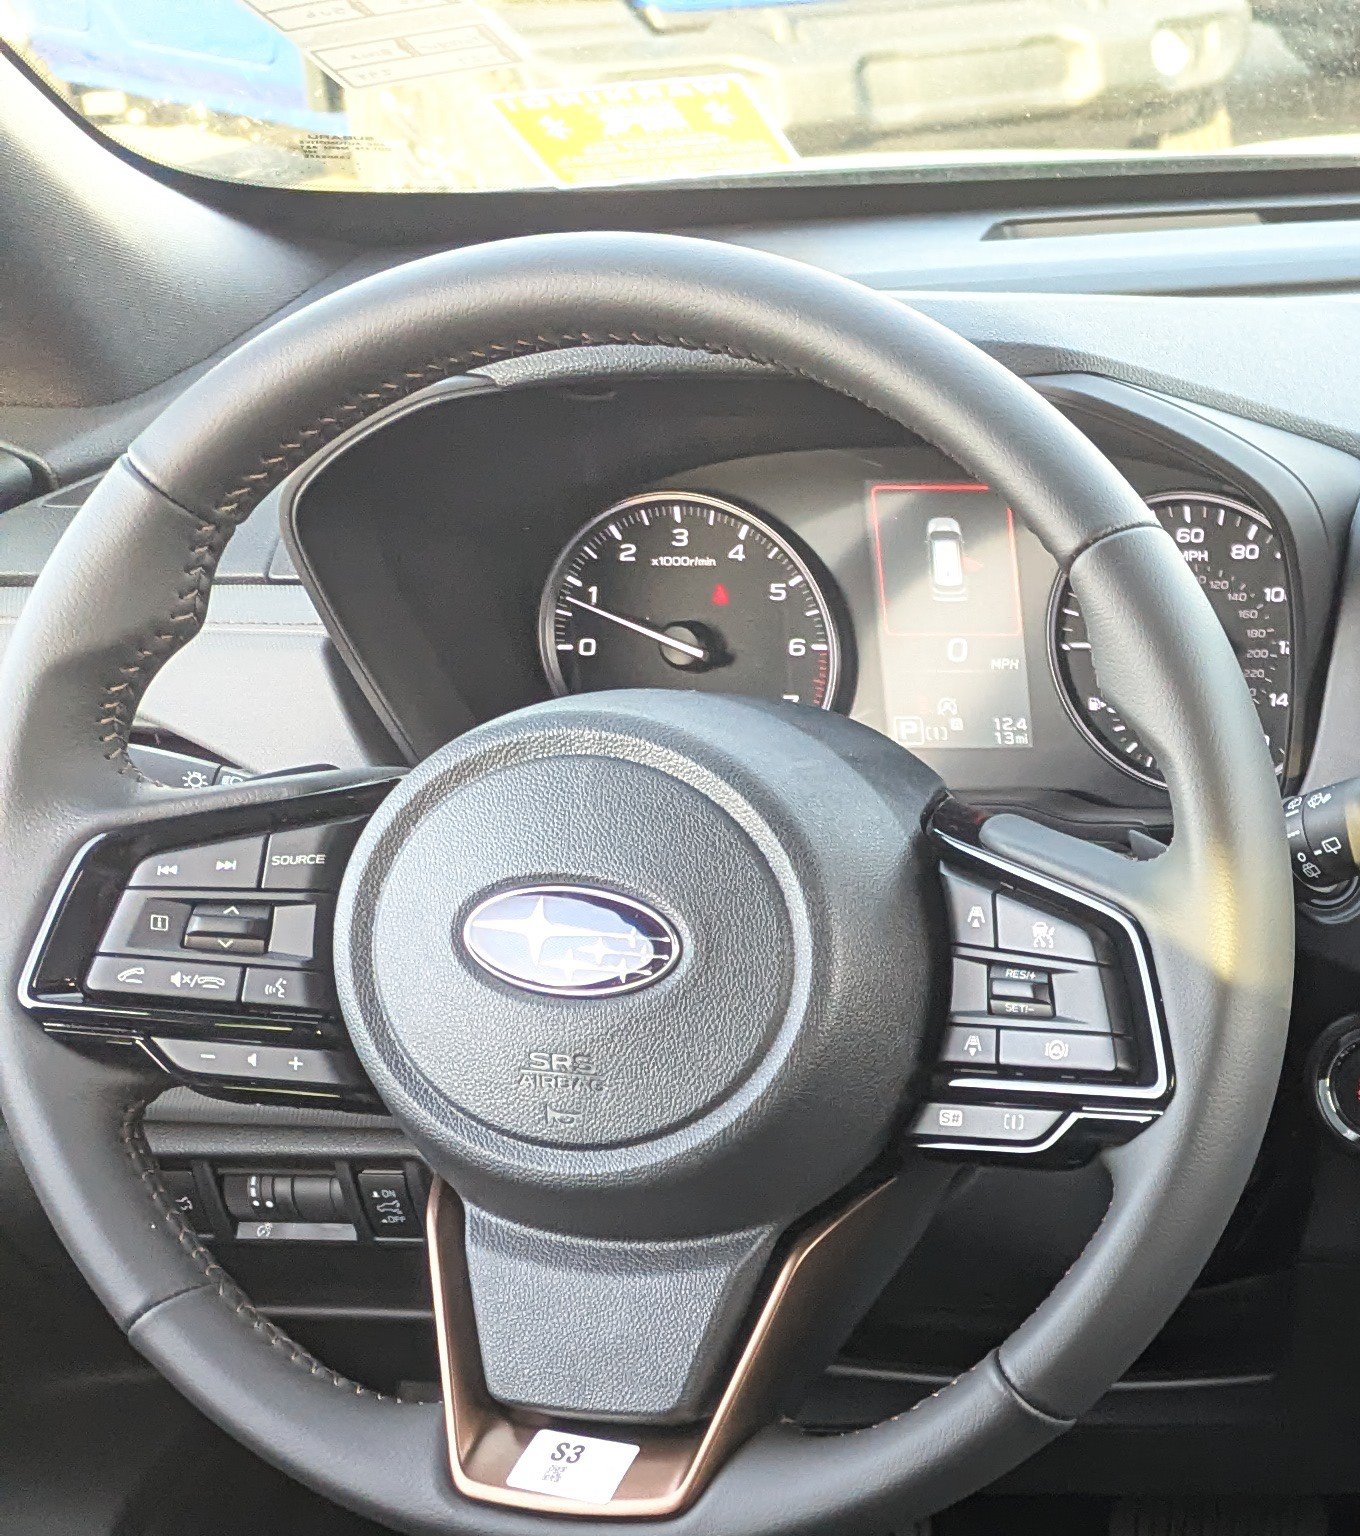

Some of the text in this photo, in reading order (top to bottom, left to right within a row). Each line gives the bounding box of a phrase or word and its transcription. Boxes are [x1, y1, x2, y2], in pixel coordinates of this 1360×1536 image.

[672, 529, 688, 546] 3
[1176, 528, 1204, 543] 60
[620, 545, 636, 562] 2
[728, 545, 746, 562] 4
[1231, 544, 1259, 560] 80
[769, 583, 787, 601] 5
[1209, 581, 1229, 589] 120
[588, 586, 598, 605] 1
[1228, 593, 1247, 601] 140
[1238, 610, 1258, 619] 160
[1247, 629, 1266, 638] 180
[578, 638, 596, 656] 0
[788, 639, 806, 656] 6
[947, 638, 968, 662] 0
[1247, 650, 1269, 658] 200
[991, 658, 1019, 670] MPH
[271, 853, 325, 866] SOURCE
[529, 1052, 597, 1073] SRS
[552, 1442, 585, 1463] S3
